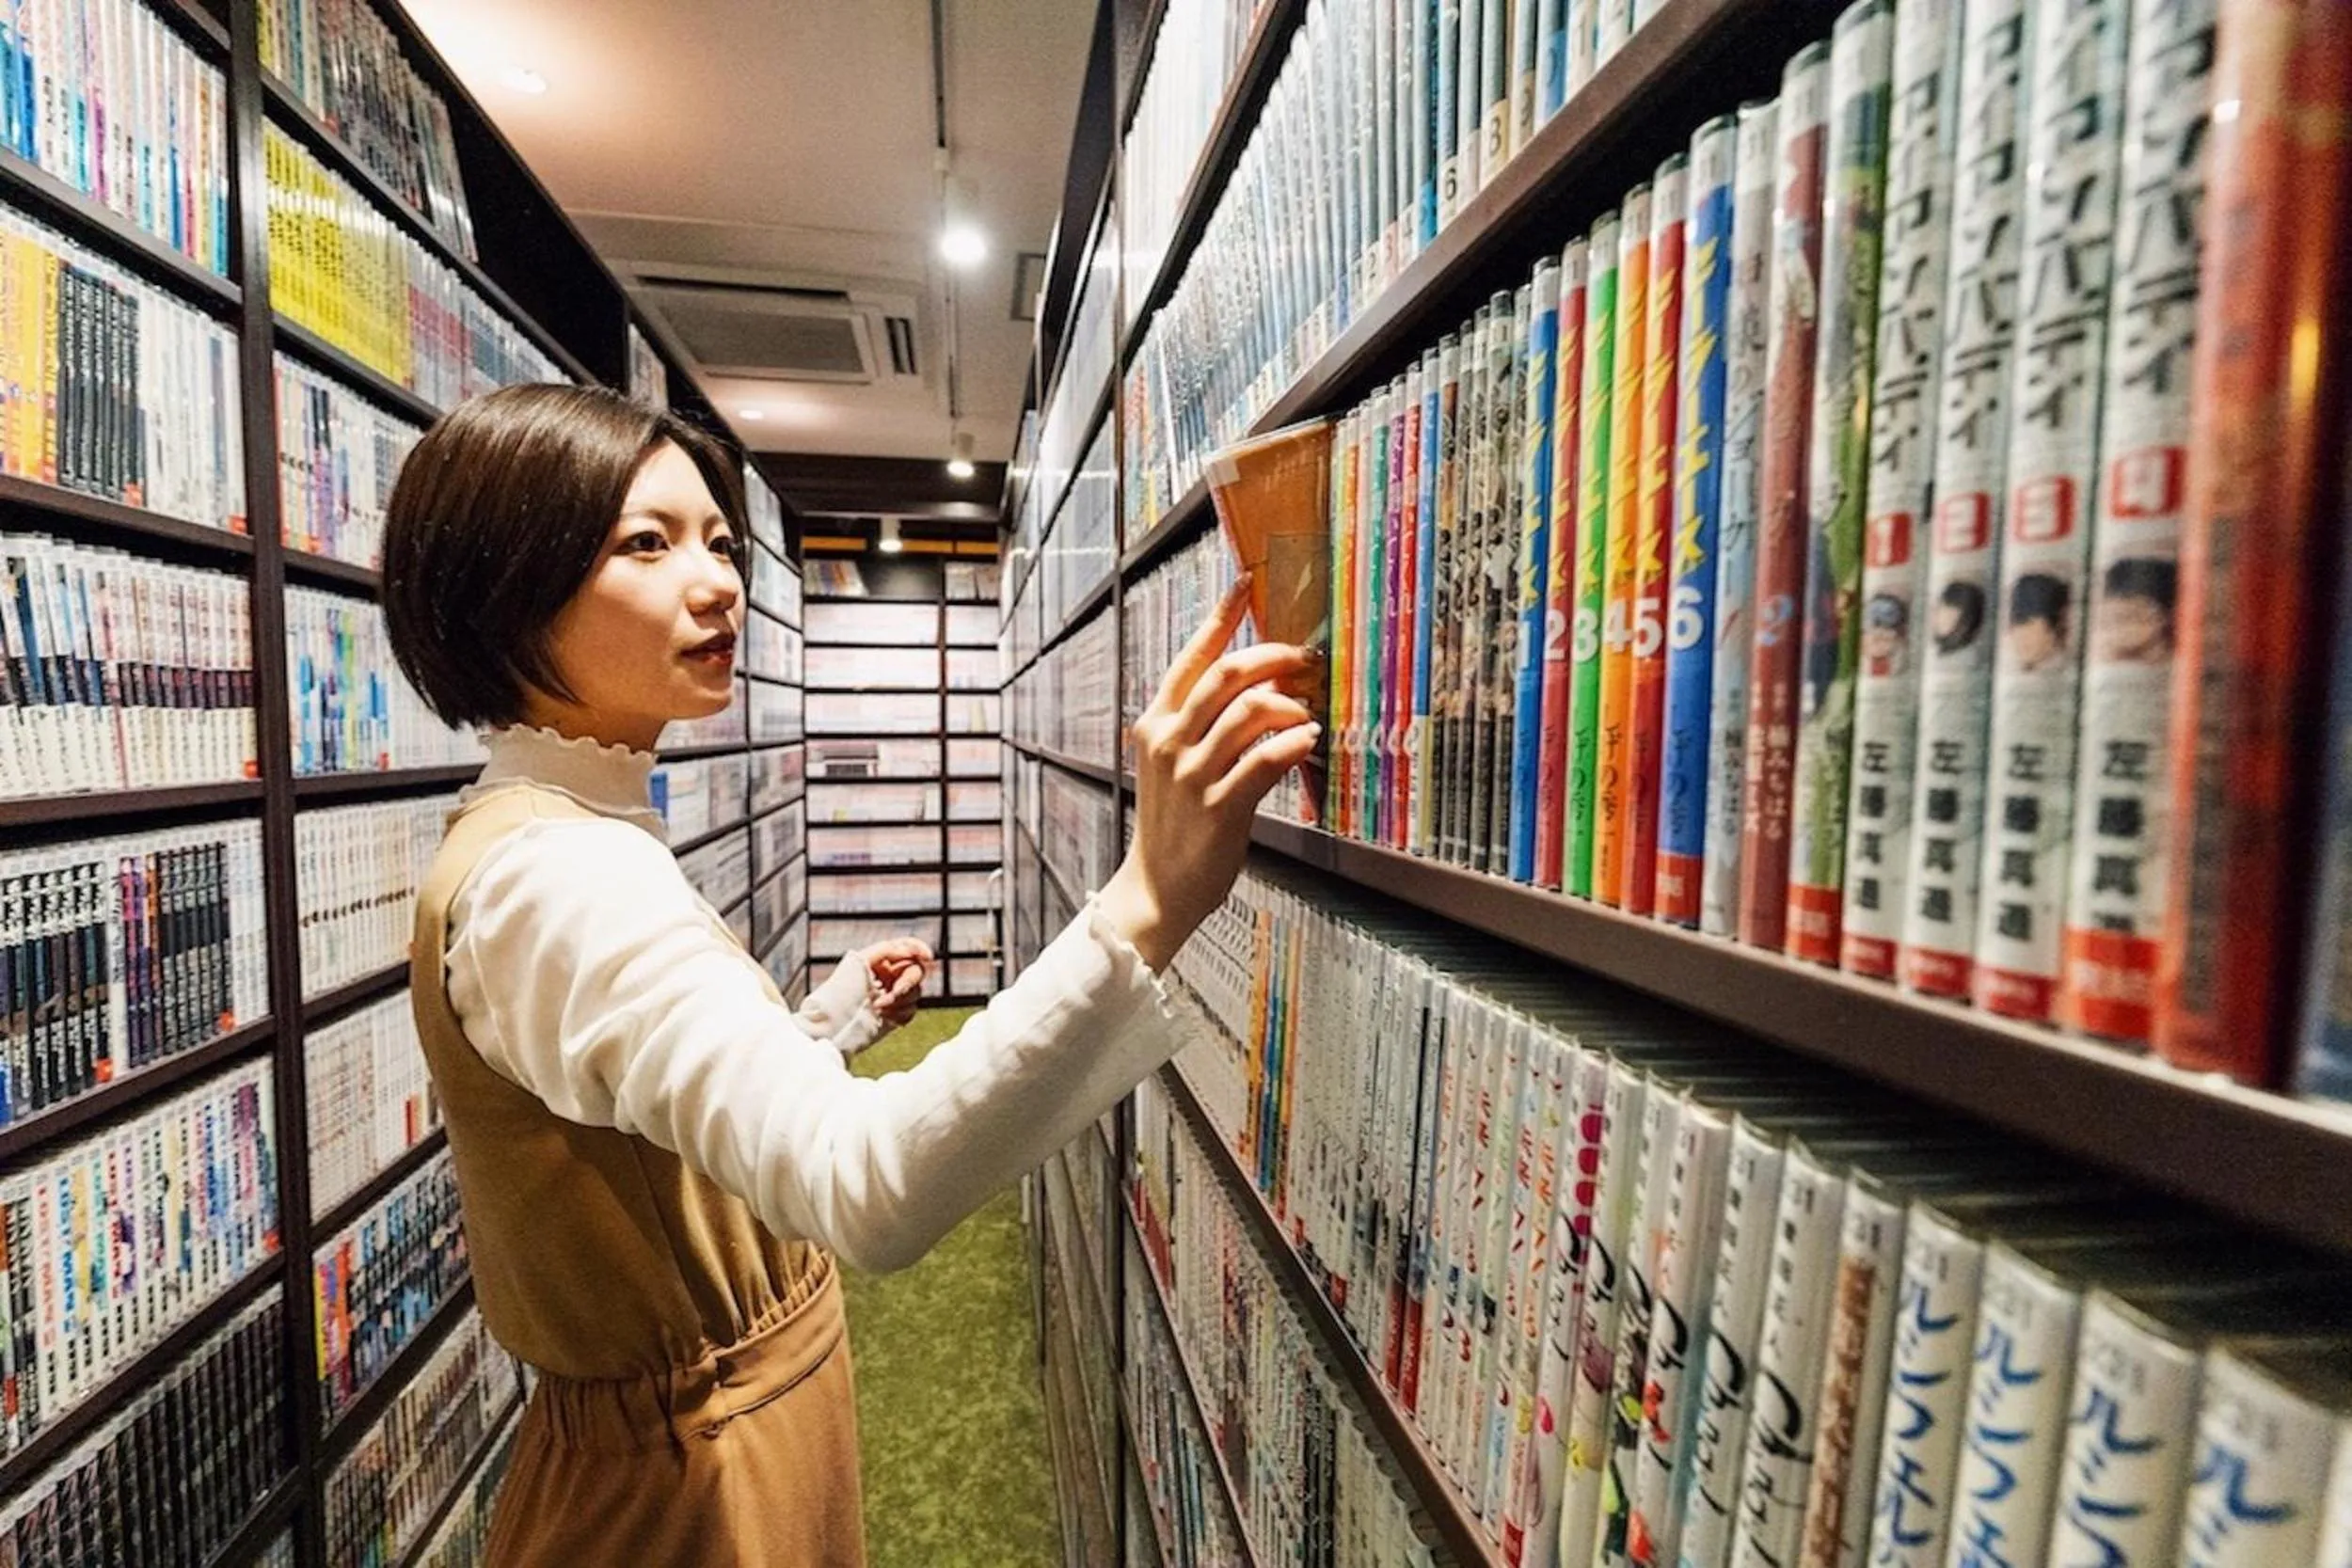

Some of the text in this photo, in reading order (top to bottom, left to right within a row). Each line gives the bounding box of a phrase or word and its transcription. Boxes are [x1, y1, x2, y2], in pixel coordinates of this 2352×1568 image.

[1444, 167, 1457, 201] 6
[1514, 620, 1533, 670] 1
[1544, 608, 1567, 661] 2
[1572, 609, 1600, 663] 3
[1602, 599, 1634, 654] 4
[1632, 596, 1664, 660] 5
[1667, 585, 1705, 651] 6
